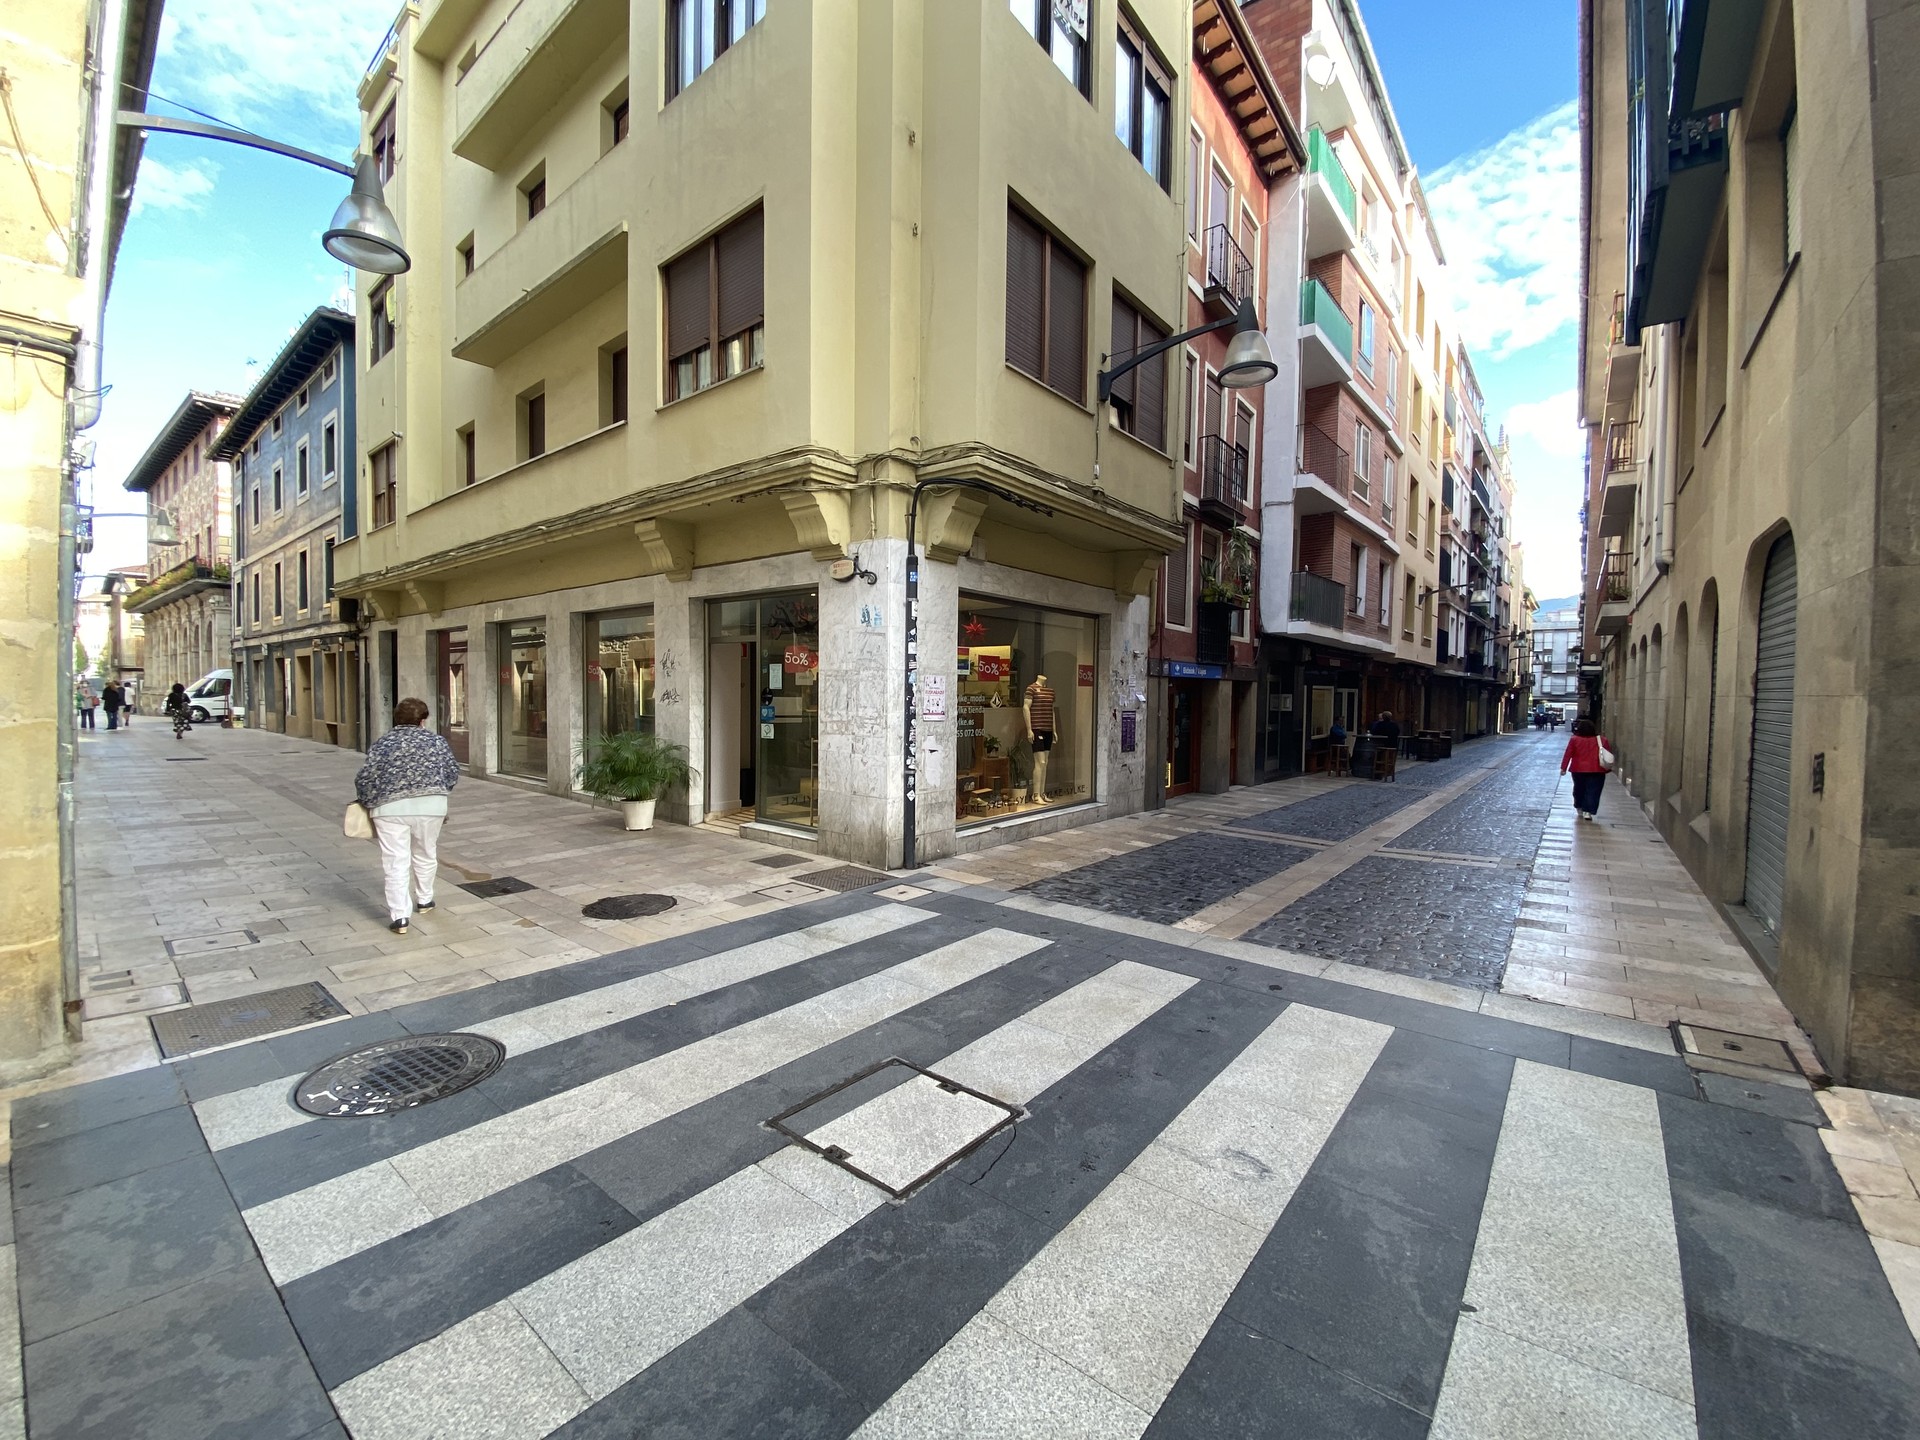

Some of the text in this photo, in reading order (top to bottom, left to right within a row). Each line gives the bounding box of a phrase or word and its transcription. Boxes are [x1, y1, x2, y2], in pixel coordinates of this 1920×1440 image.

[784, 652, 809, 666] 50%
[978, 660, 1000, 676] 50%
[1079, 669, 1093, 682] 50%
[965, 729, 974, 737] 072
[1066, 784, 1086, 795] SYLKE
